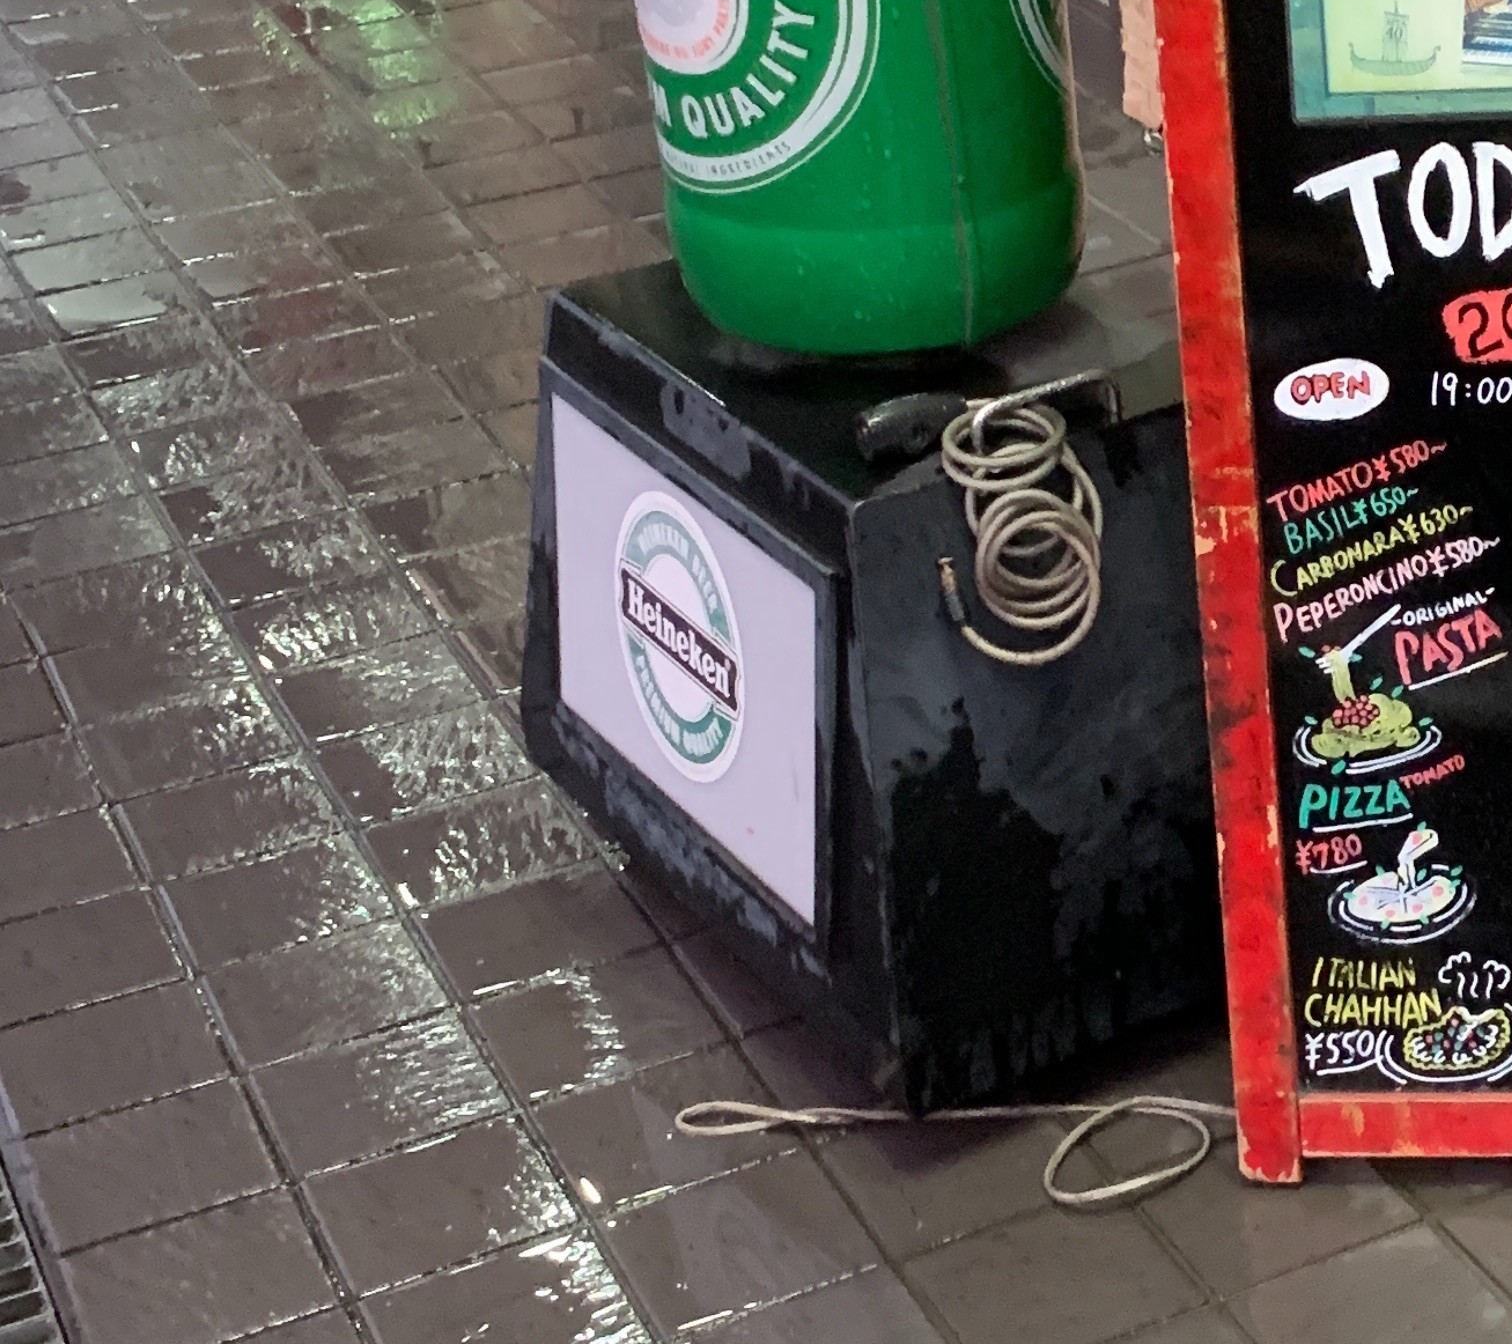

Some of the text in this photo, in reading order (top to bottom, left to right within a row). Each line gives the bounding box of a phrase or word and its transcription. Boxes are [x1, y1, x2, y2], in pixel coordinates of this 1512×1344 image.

[682, 0, 816, 140] QUALITY
[1289, 370, 1372, 405] OPEN
[1266, 461, 1373, 523] TOMATO
[1283, 504, 1357, 556] BASIL
[1273, 555, 1429, 644] PEPERONCINO
[626, 578, 731, 698] Heineken
[1394, 609, 1503, 686] PASTA
[1298, 754, 1466, 829] PIZZA TOMATO
[1295, 833, 1363, 874] ¥780
[1311, 956, 1418, 989] ITALIAN
[1304, 986, 1443, 1028] CHAHHAN
